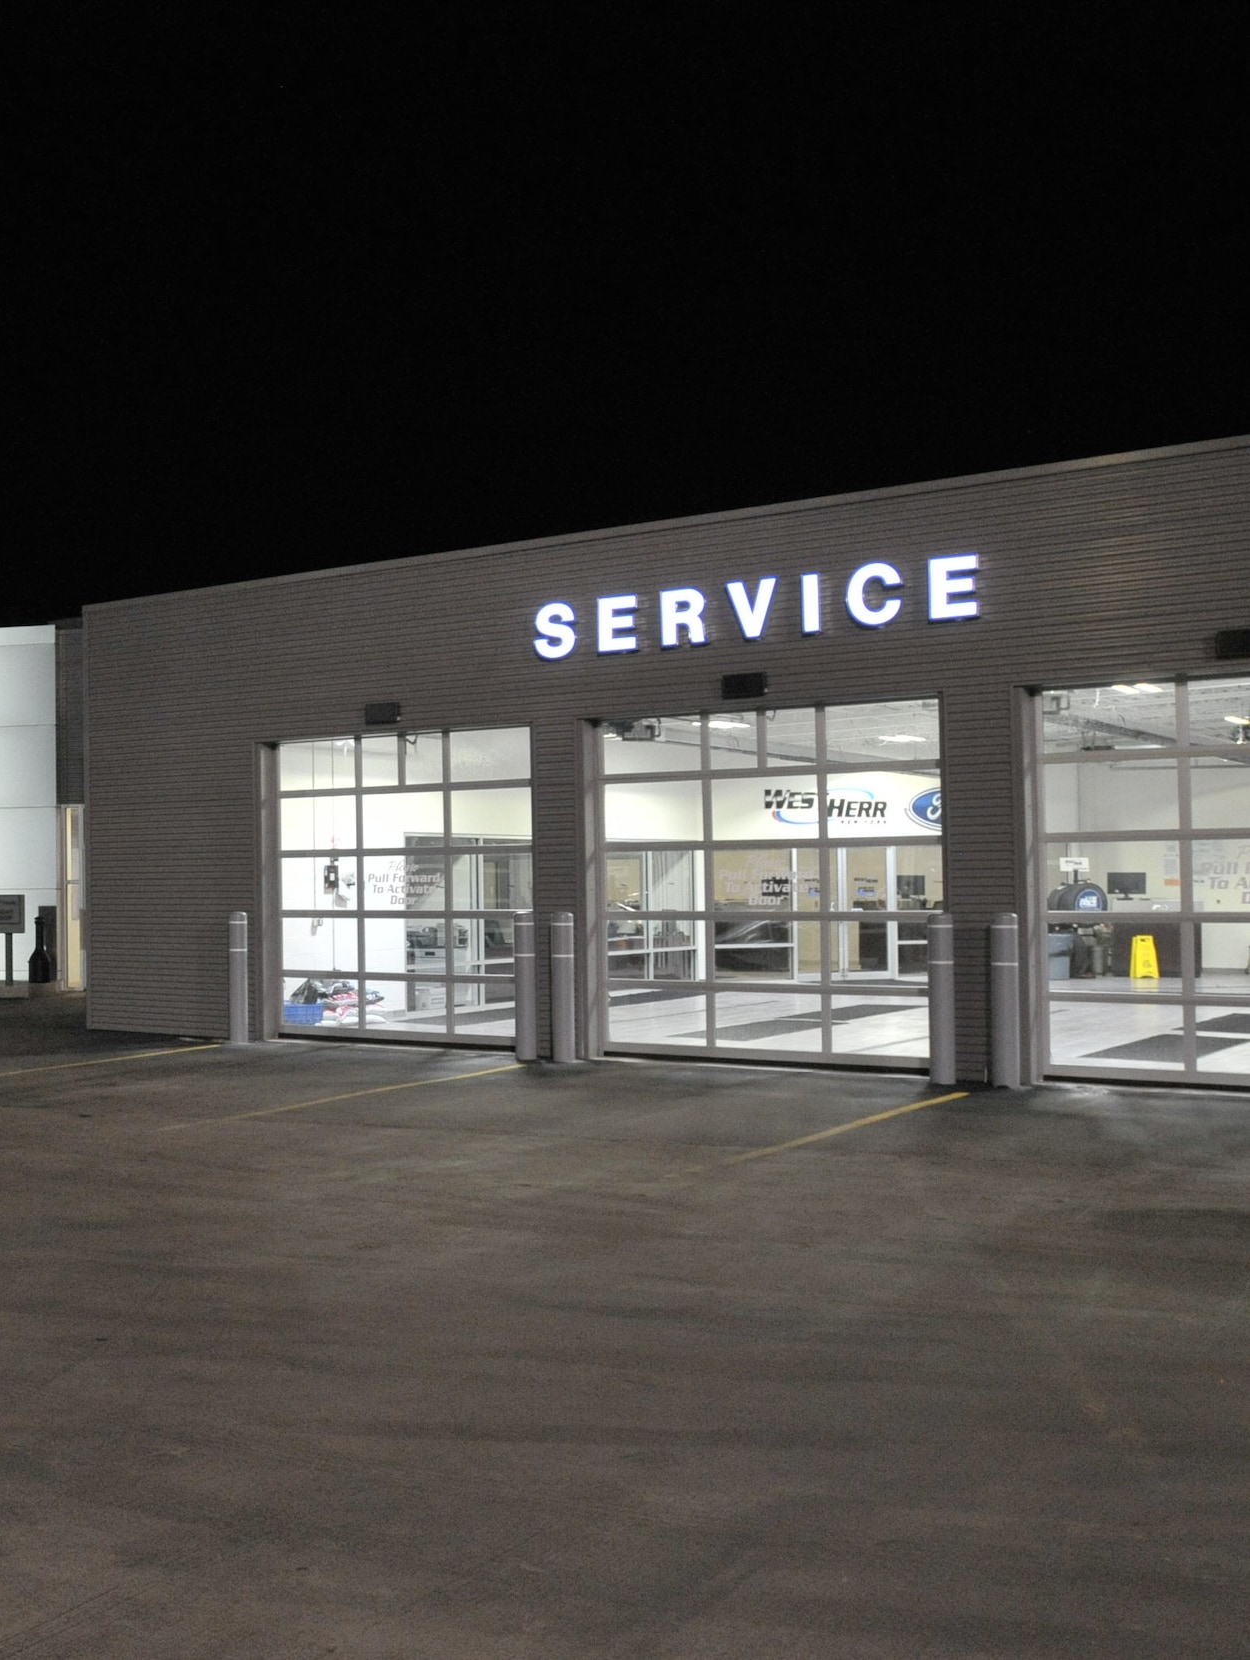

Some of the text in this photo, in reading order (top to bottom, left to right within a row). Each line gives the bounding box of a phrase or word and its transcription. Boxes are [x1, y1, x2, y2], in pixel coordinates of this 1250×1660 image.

[533, 553, 980, 661] SERVICE
[764, 789, 830, 810] WES
[827, 799, 887, 818] HERR
[368, 872, 441, 882] Pull Forward
[1209, 877, 1229, 889] To
[373, 884, 384, 893] To
[725, 881, 741, 893] To
[390, 895, 418, 905] Door
